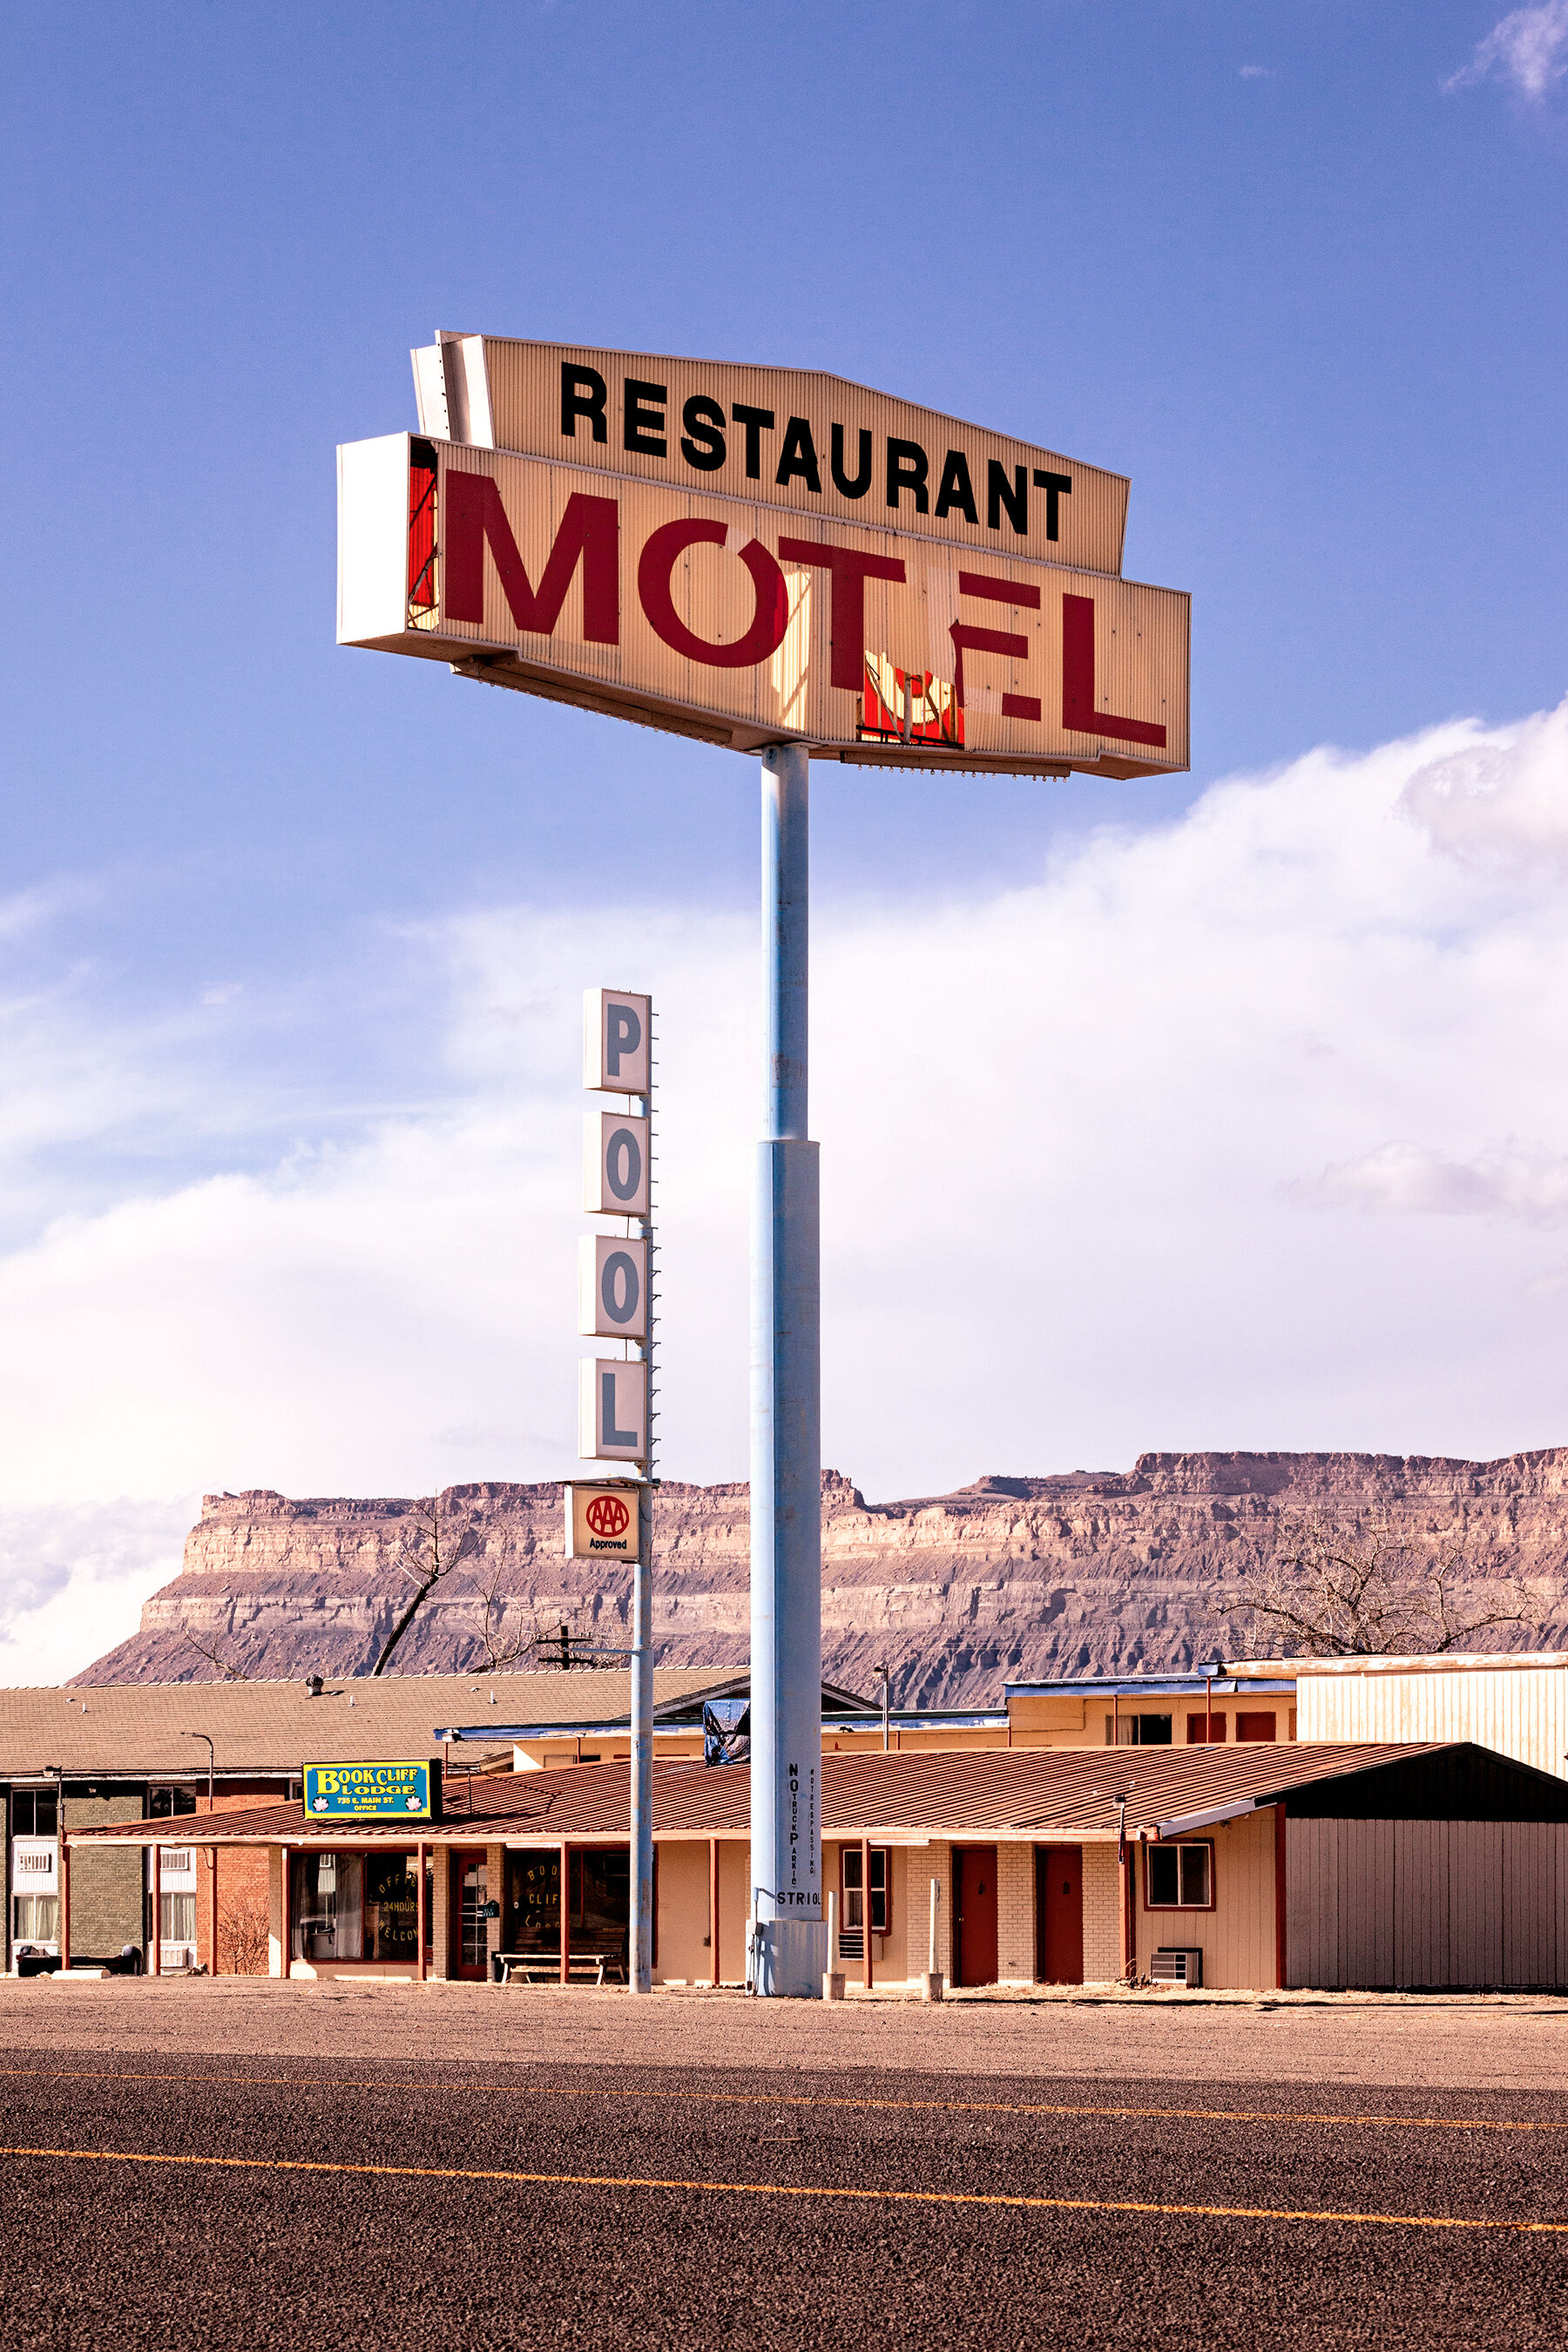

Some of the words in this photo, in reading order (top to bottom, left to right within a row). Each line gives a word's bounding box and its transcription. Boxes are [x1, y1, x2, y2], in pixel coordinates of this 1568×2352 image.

[561, 361, 1072, 542] RESTAURANT
[444, 469, 1166, 748] MOTEL
[600, 1003, 642, 1449] POOL
[588, 1496, 627, 1538] AAA
[589, 1538, 627, 1550] Approved
[316, 1769, 375, 1794] BOOK
[376, 1768, 418, 1786] CLIFF
[341, 1784, 416, 1795] LODGE
[789, 1763, 799, 1793] NO
[378, 1874, 418, 1894] OFFIC
[527, 1865, 558, 1882] BOO
[529, 1893, 558, 1905] CLIF
[378, 1919, 419, 1942] WELCOM
